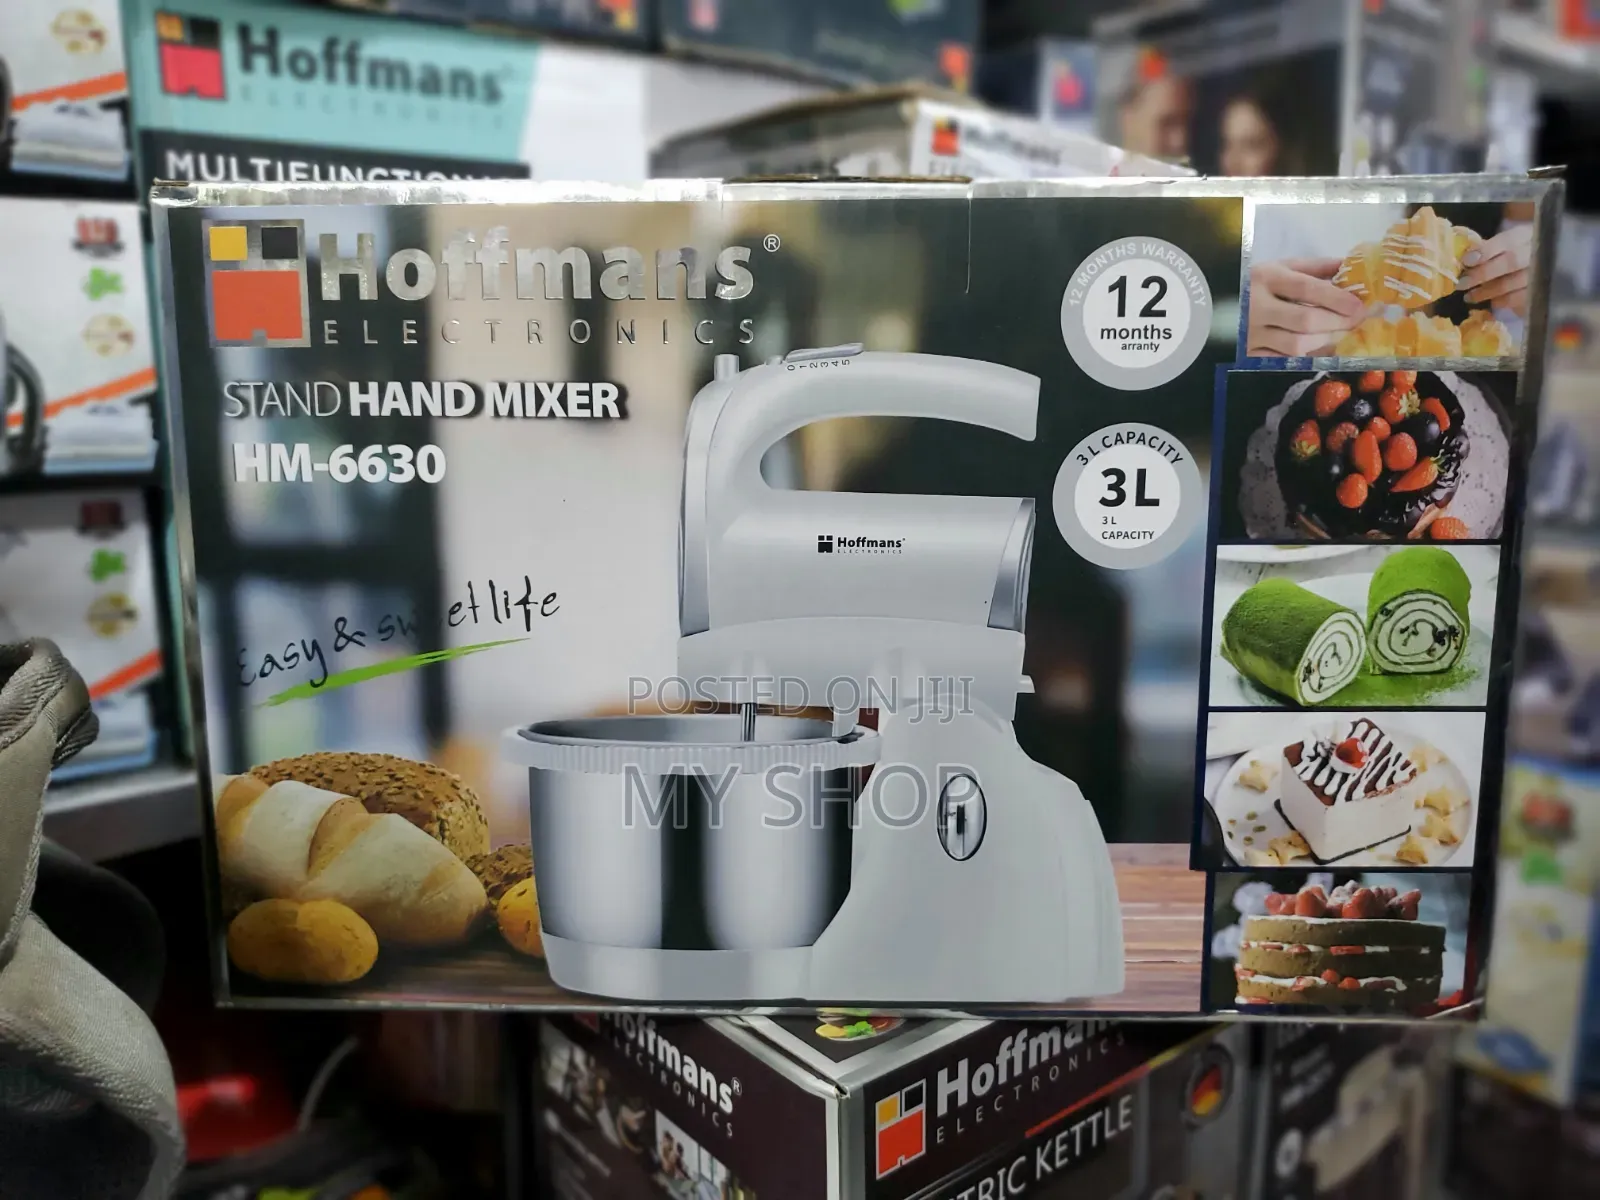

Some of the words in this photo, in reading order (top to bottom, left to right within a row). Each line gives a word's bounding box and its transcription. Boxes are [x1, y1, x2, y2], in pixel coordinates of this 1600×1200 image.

[1068, 288, 1084, 307] 12
[1077, 242, 1137, 287] MONTHS
[1141, 242, 1207, 306] WARRANTY
[1108, 275, 1168, 318] 12
[323, 318, 755, 346] ELECTRONICS
[1100, 324, 1173, 340] months
[1121, 341, 1160, 353] arranty
[223, 381, 341, 417] STAND
[350, 381, 476, 417] HAND
[483, 382, 621, 418] MIXER
[232, 442, 446, 484] HM-6630
[1076, 453, 1089, 466] 3
[1087, 444, 1101, 457] L
[1101, 431, 1184, 465] CAPACITY
[1098, 467, 1160, 508] 3L
[1101, 531, 1155, 540] CAPACITY
[333, 616, 367, 652] &
[376, 580, 481, 642] swet
[488, 575, 561, 632] life
[606, 1032, 734, 1138] LECTRONICS
[936, 1032, 1125, 1144] ELECTRONICS
[937, 1019, 1118, 1118] Hoffman
[1035, 1094, 1133, 1180] KETTLE
